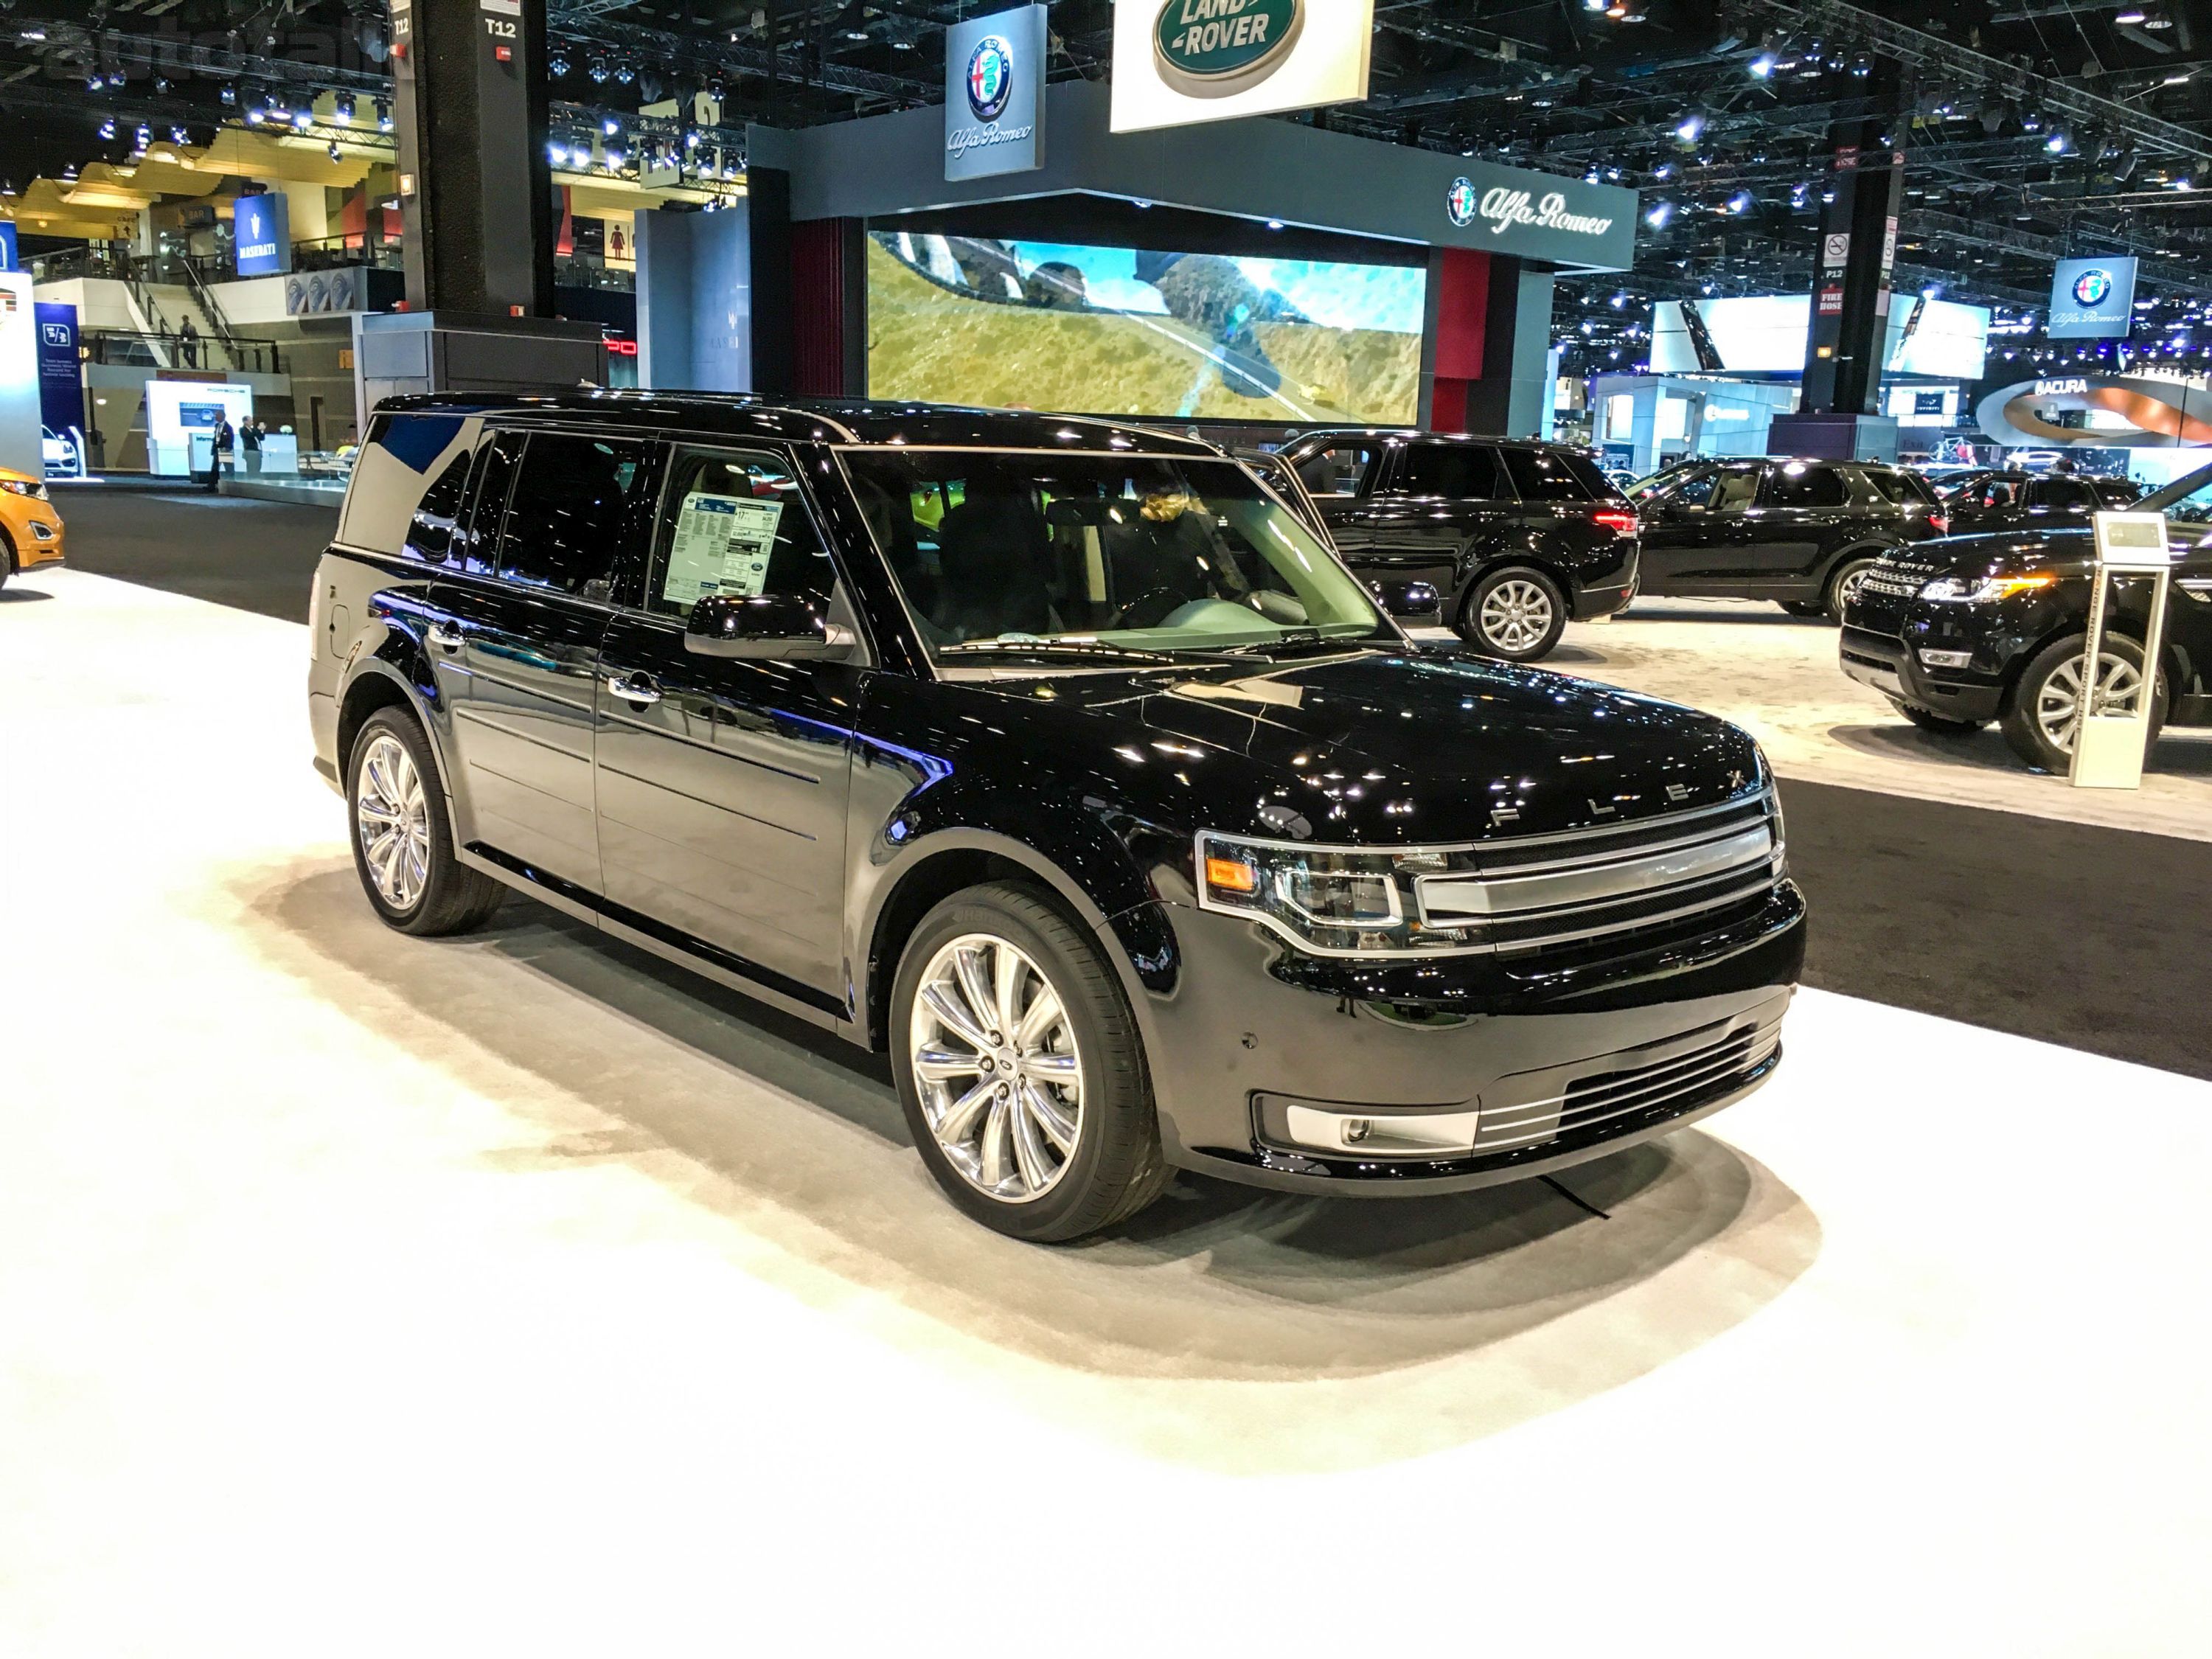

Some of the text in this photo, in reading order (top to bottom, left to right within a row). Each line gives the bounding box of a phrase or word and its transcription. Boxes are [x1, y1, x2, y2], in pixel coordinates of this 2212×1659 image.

[1180, 0, 1245, 24] LAND
[394, 18, 408, 35] T12
[484, 18, 516, 38] T12
[1184, 13, 1269, 56] ROVER
[947, 122, 1033, 159] Alfa Romeo
[189, 209, 204, 220] BAR
[1480, 187, 1613, 235] Alfa Romeo
[240, 243, 276, 259] MASERATI
[1826, 270, 1843, 278] P12
[1820, 302, 1843, 310] HOSE
[1822, 293, 1843, 302] FIRE
[2051, 310, 2127, 327] Alfa Romeo
[2043, 379, 2088, 395] ACURA
[2092, 570, 2101, 612] RANGE
[2086, 617, 2096, 658] ROVER
[1491, 770, 1747, 827] FLEX
